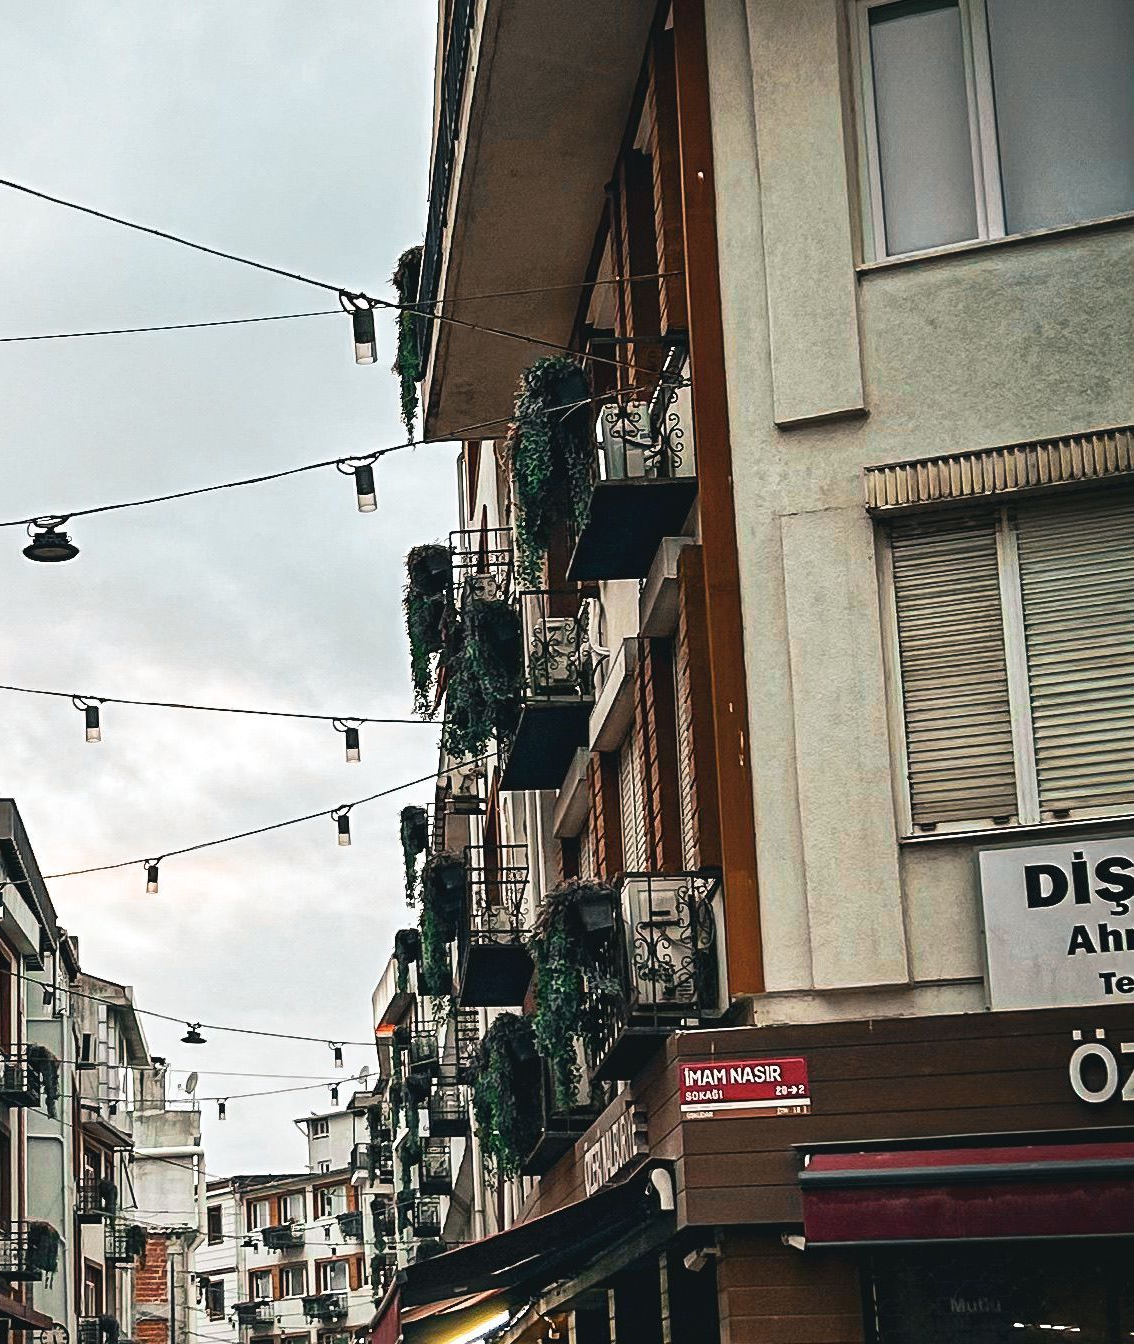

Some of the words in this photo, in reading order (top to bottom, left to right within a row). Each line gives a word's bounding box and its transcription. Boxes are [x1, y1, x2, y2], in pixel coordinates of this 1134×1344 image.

[1023, 850, 1134, 916] DİŞ
[1067, 922, 1134, 956] Ah
[684, 1067, 726, 1087] İMAM
[730, 1065, 782, 1084] NASIR
[685, 1089, 724, 1102] SOKAĞI
